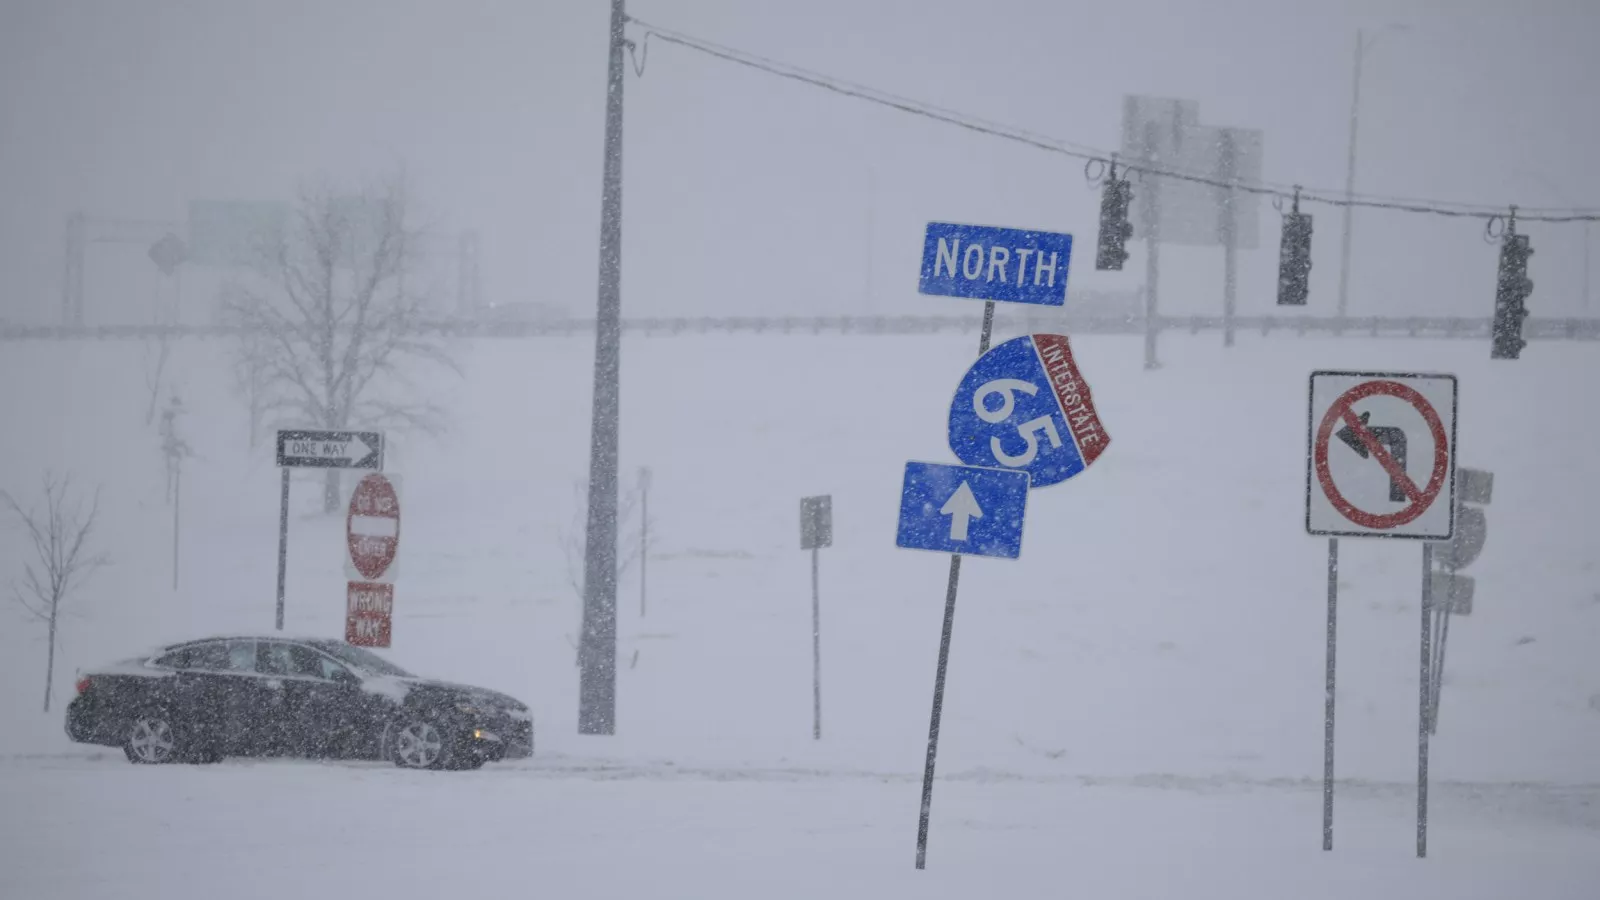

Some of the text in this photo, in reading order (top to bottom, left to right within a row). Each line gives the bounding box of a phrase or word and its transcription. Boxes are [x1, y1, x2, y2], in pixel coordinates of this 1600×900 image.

[933, 237, 1058, 289] NORTH
[1042, 343, 1100, 447] INTERSTATE
[973, 378, 1063, 468] 65
[291, 442, 348, 457] ONE WAY
[350, 590, 392, 615] WRONG
[356, 616, 383, 638] WAY
